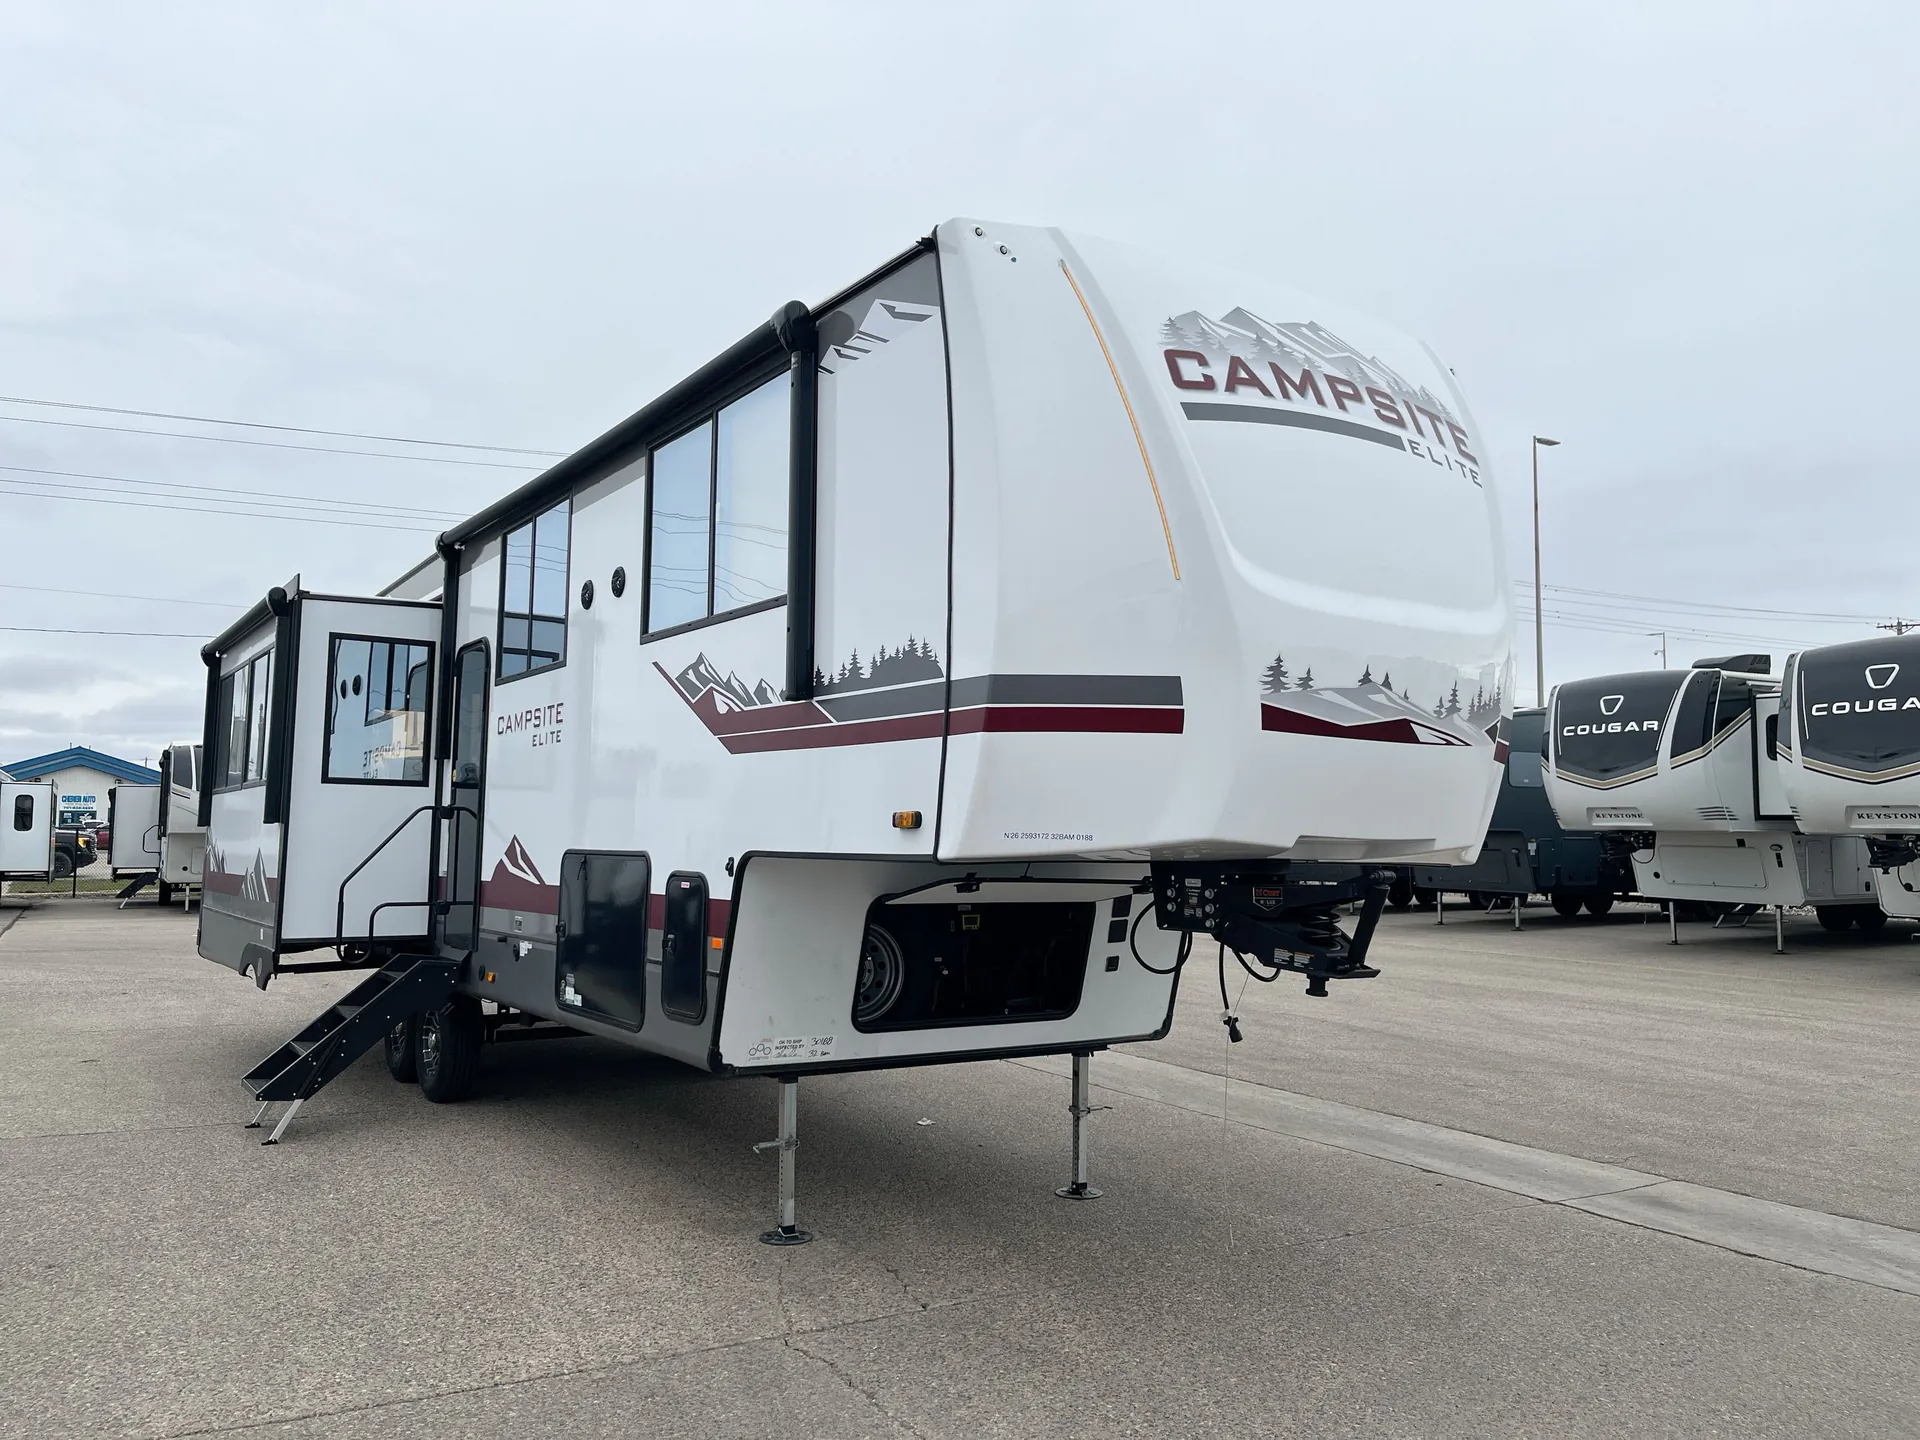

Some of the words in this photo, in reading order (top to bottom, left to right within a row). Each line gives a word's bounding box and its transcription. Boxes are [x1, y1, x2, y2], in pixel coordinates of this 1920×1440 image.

[1163, 348, 1480, 468] CAMPSITE
[1407, 438, 1483, 489] ELITE
[497, 702, 564, 735] CAMPSITE
[1562, 720, 1659, 737] COUGAR
[532, 730, 562, 747] ELITE
